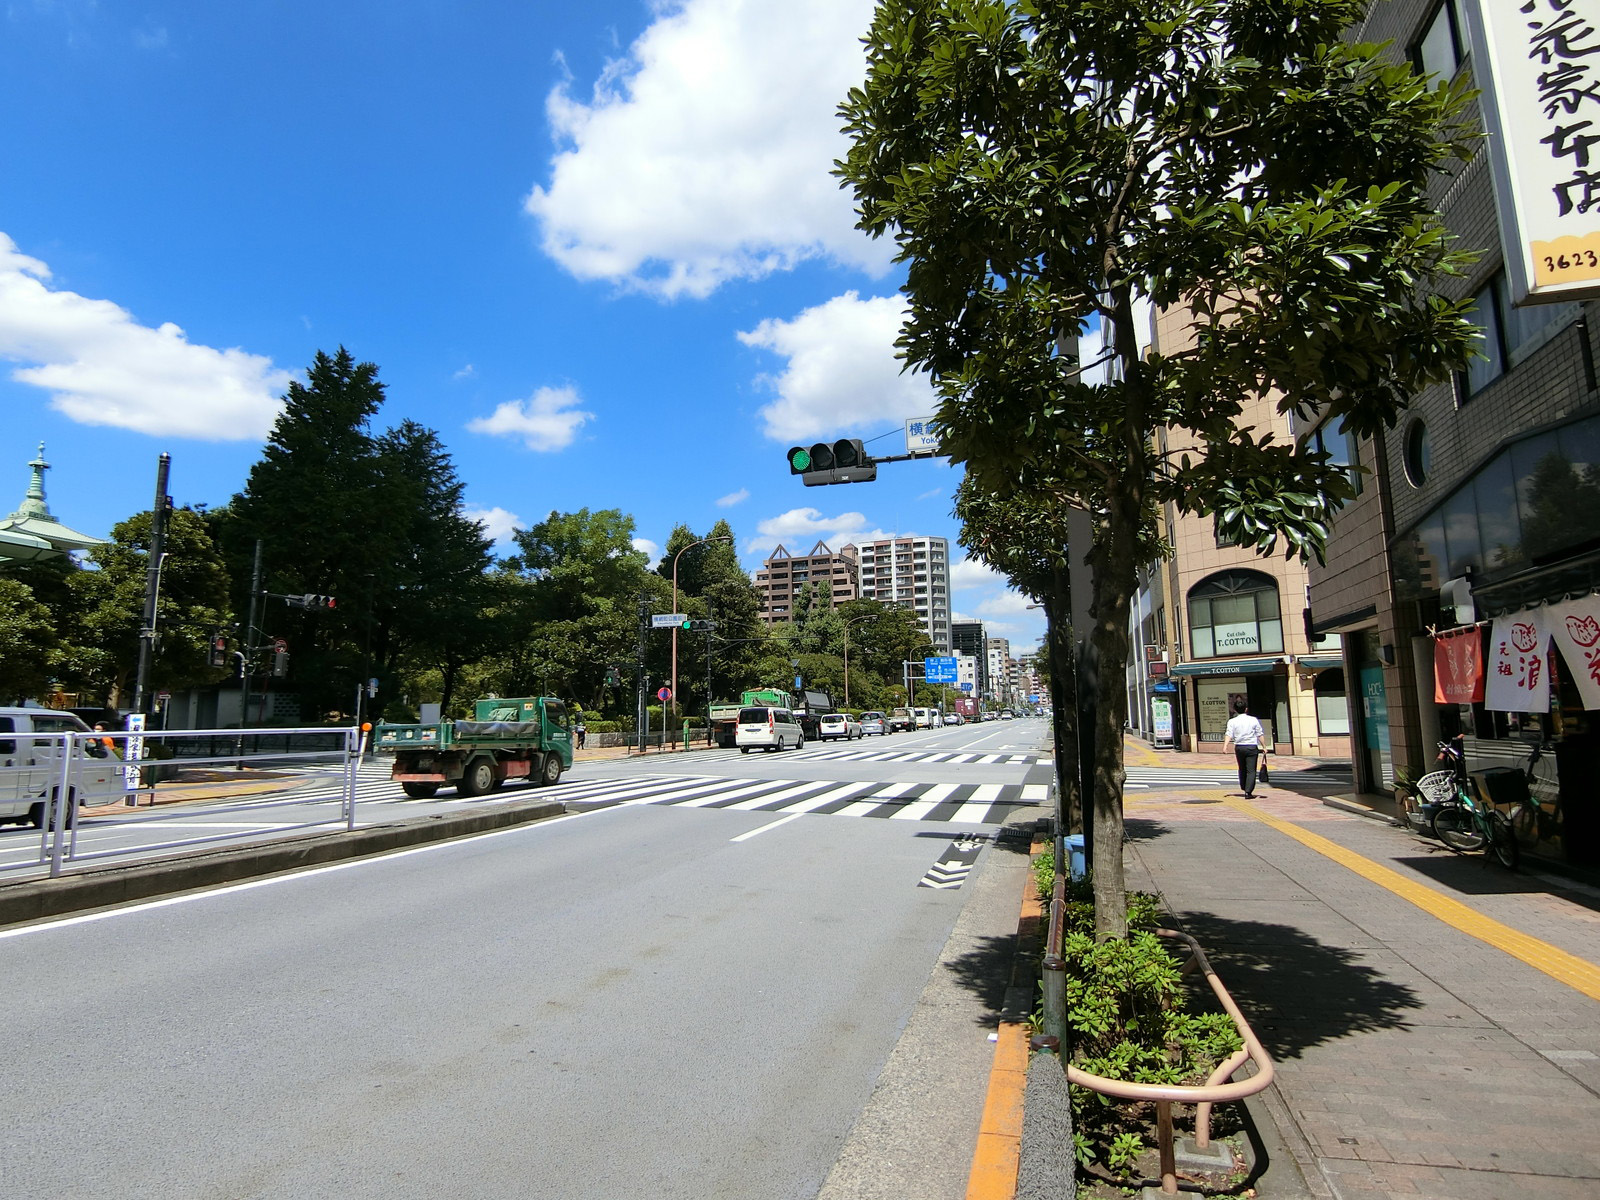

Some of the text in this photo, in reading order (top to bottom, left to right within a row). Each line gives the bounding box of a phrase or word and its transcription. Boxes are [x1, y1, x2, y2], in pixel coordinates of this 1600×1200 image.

[1519, 0, 1600, 217] 花家本店
[1544, 250, 1598, 272] 3623
[921, 436, 944, 444] Yoko
[1217, 636, 1258, 647] T.COTTON
[1497, 642, 1513, 676] 元祖
[1517, 655, 1542, 690] 浪
